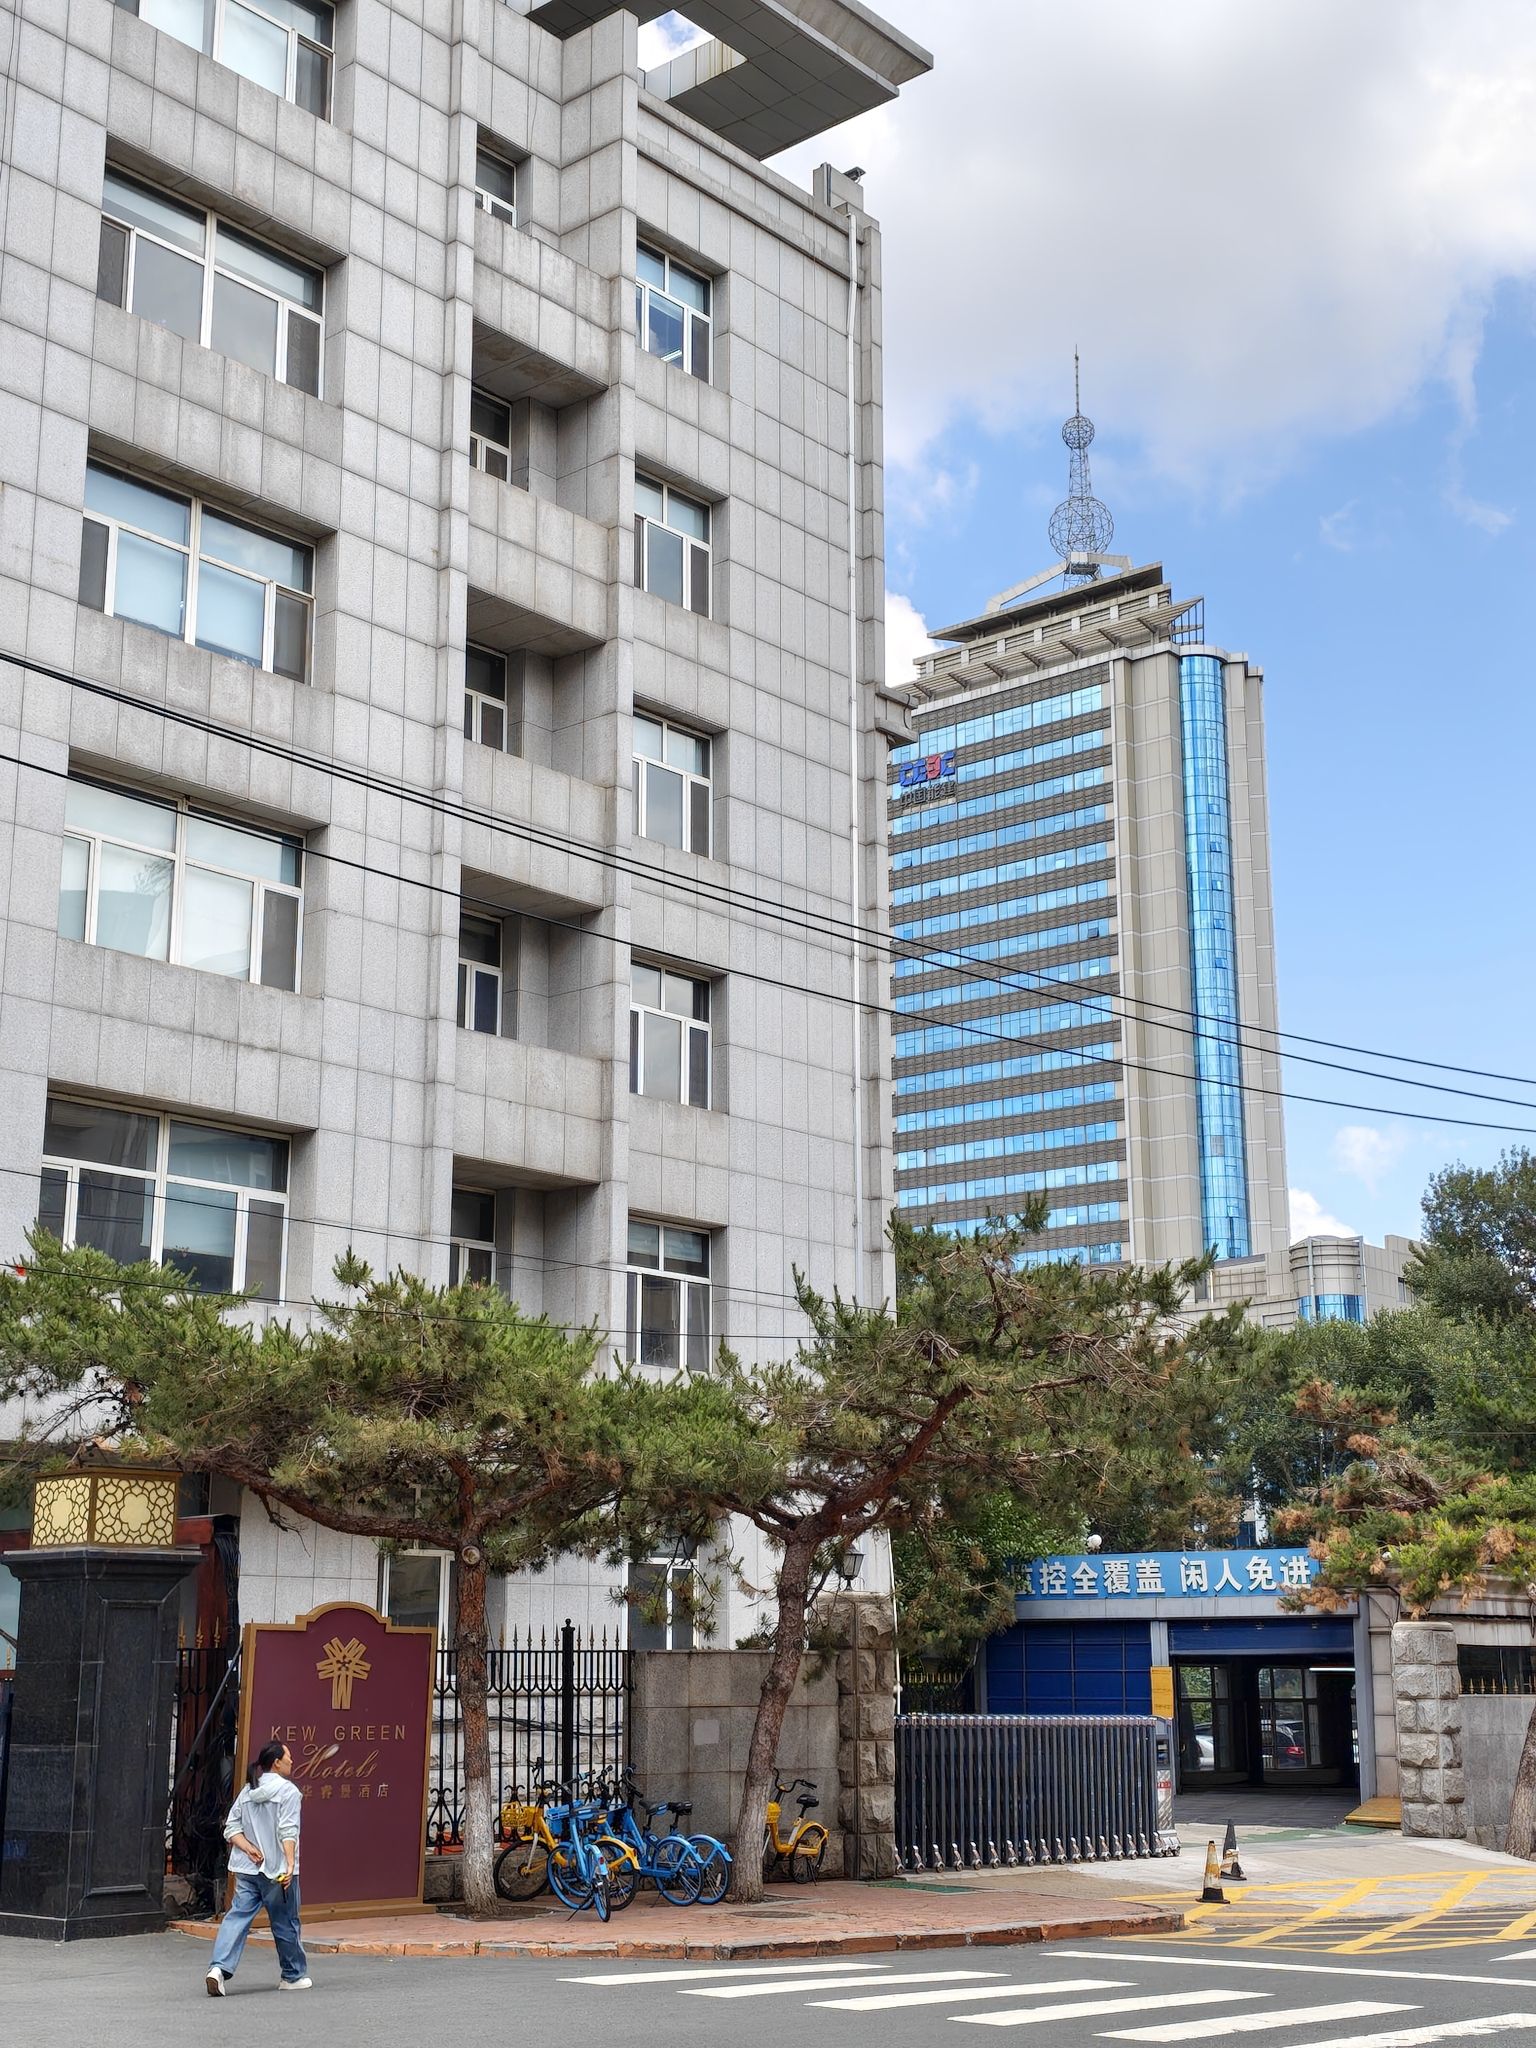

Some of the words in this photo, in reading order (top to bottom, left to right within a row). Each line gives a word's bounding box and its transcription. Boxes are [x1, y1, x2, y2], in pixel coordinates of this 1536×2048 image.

[1180, 1555, 1312, 1593] 闲人免进
[271, 1725, 317, 1741] KEW
[334, 1724, 406, 1740] GREEN
[292, 1743, 379, 1779] Hotels
